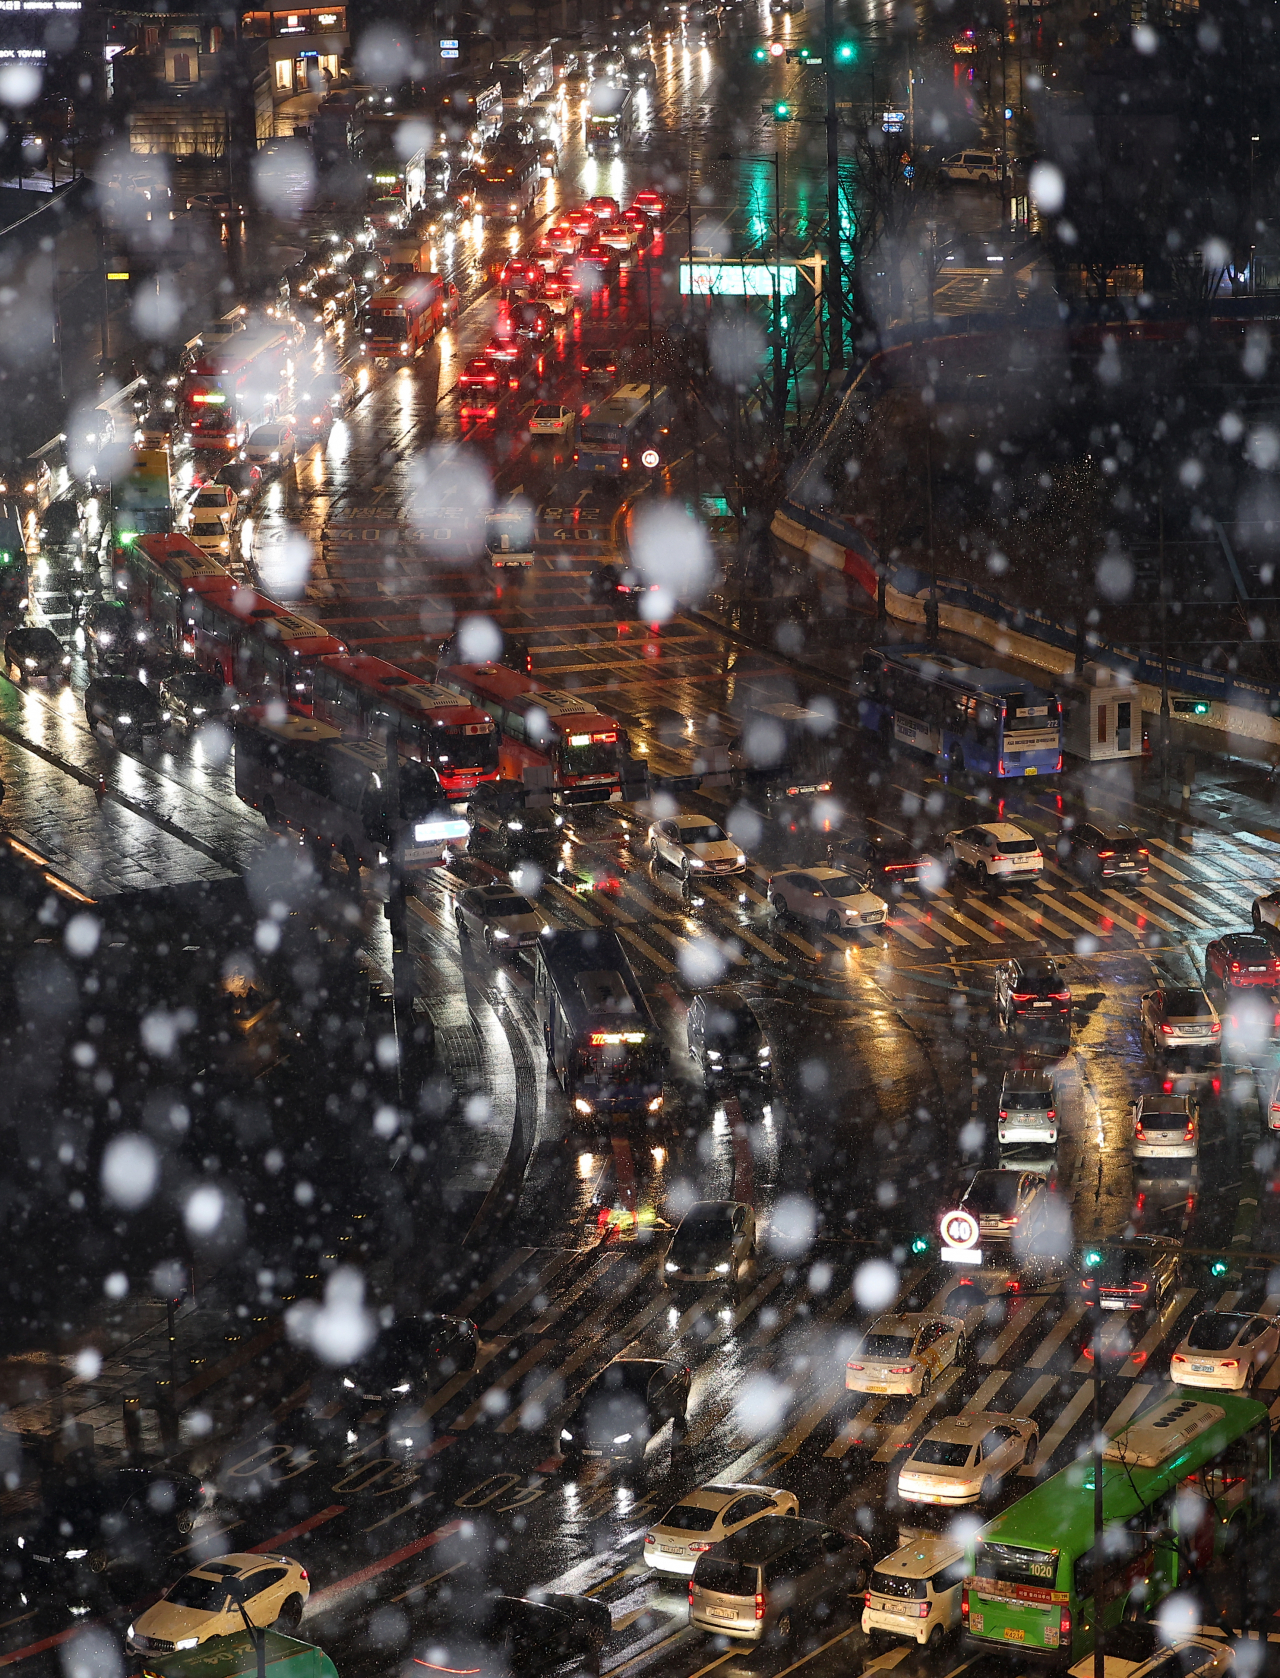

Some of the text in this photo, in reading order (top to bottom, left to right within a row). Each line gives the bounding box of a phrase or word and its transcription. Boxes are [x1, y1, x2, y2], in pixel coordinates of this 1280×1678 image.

[340, 528, 380, 541] 40
[412, 528, 452, 540] 40
[553, 528, 594, 540] 40
[1047, 720, 1058, 728] 272
[592, 1033, 605, 1044] 272
[949, 1220, 970, 1240] 40
[1030, 1563, 1052, 1578] 1020
